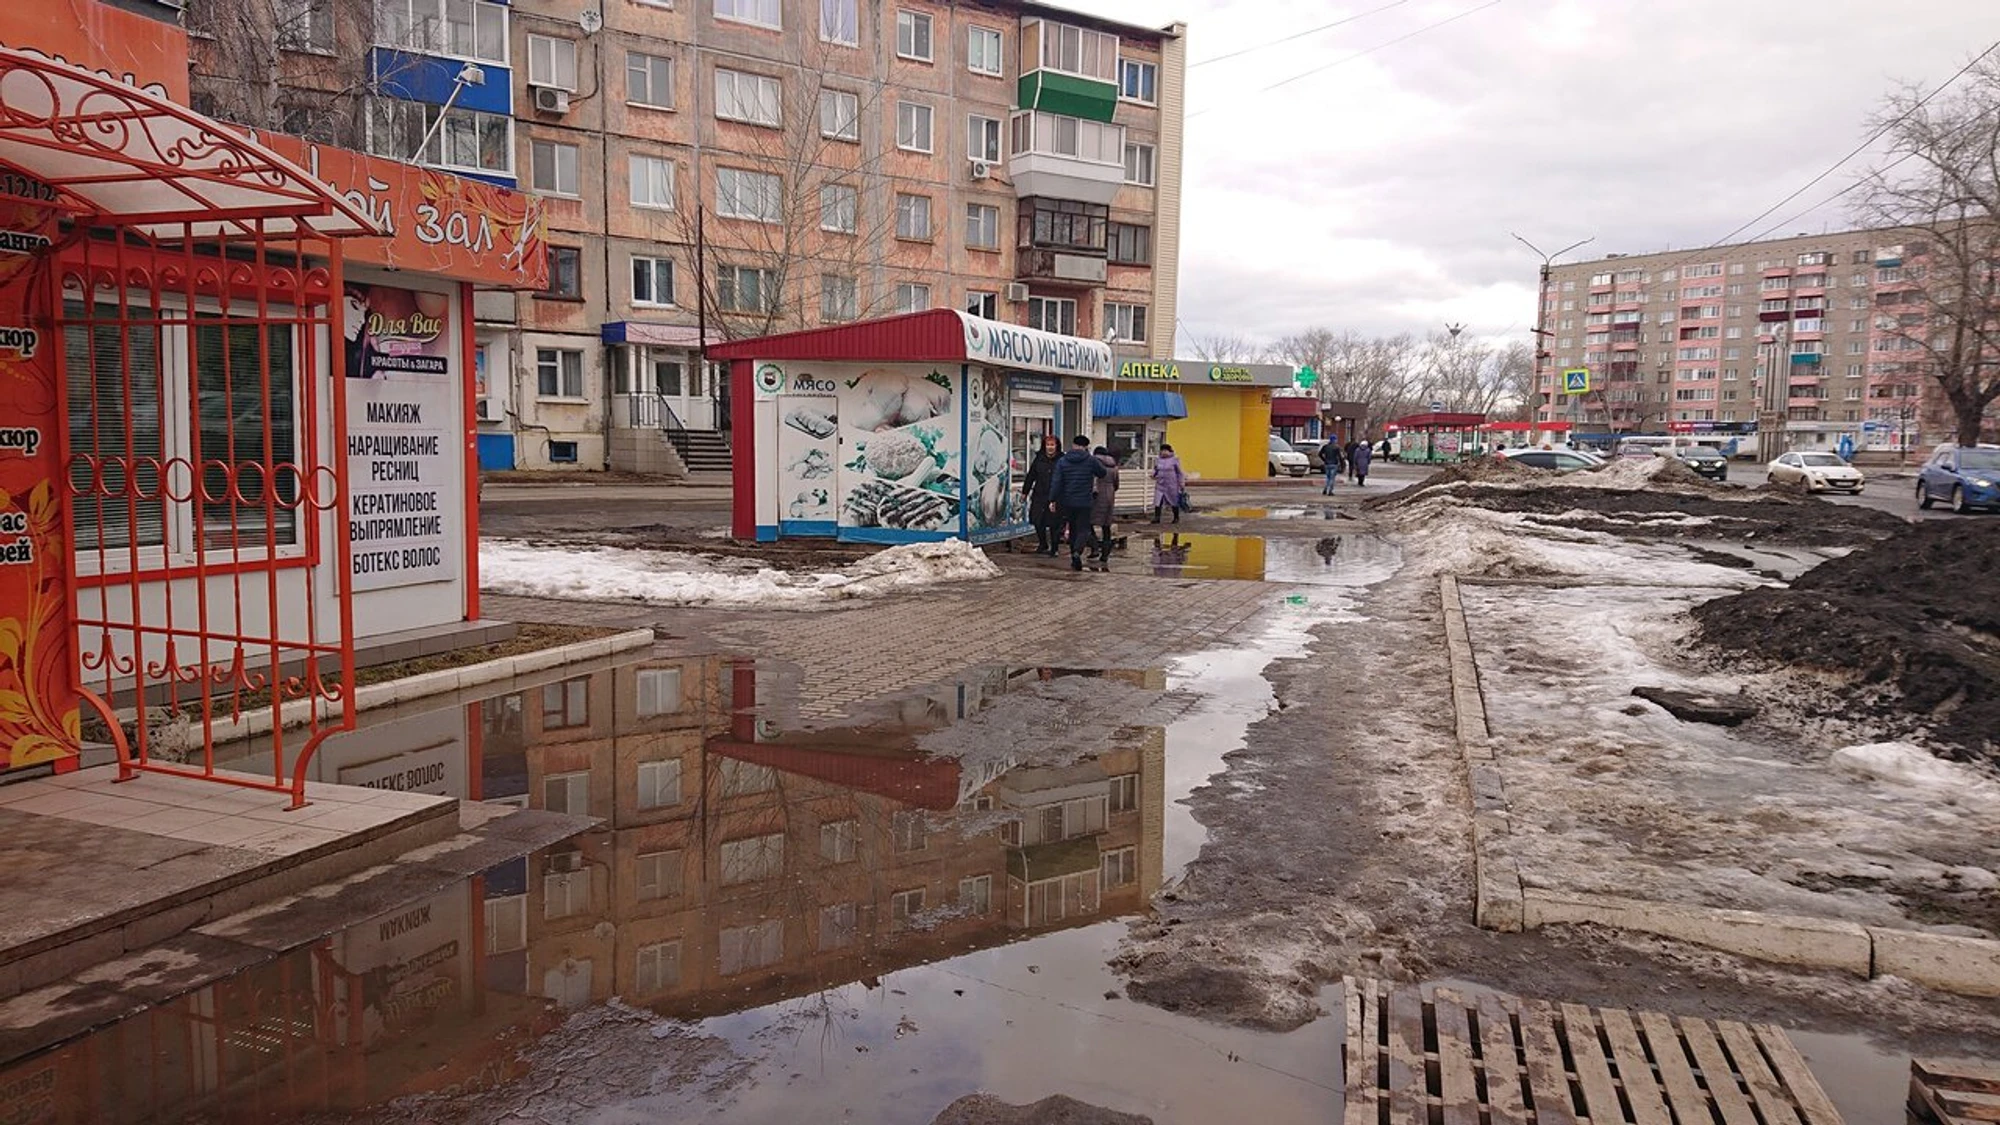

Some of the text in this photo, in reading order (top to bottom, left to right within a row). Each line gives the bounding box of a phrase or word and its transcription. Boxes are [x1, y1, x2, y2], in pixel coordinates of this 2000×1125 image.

[415, 203, 495, 253] зал
[368, 312, 442, 336] Для Вас
[0, 328, 37, 355] юр
[988, 327, 1100, 373] МЯСО ИНДЕЙКИ
[371, 356, 409, 369] КРАСОТЫ
[416, 360, 443, 370] ЗАГАРА
[1120, 362, 1180, 379] АПТЕКА
[793, 380, 836, 392] МЯСО
[367, 402, 421, 424] МАКИЯЖ
[348, 435, 439, 458] НАРАЩИВАНИЕ
[372, 461, 419, 482] РЕСНИЦ
[353, 491, 437, 516] КЕРАТИНОВОЕ
[349, 515, 442, 542] ВЫПРЯМЛЕНИЕ
[353, 546, 441, 574] БОТЕКС ВОЛОС
